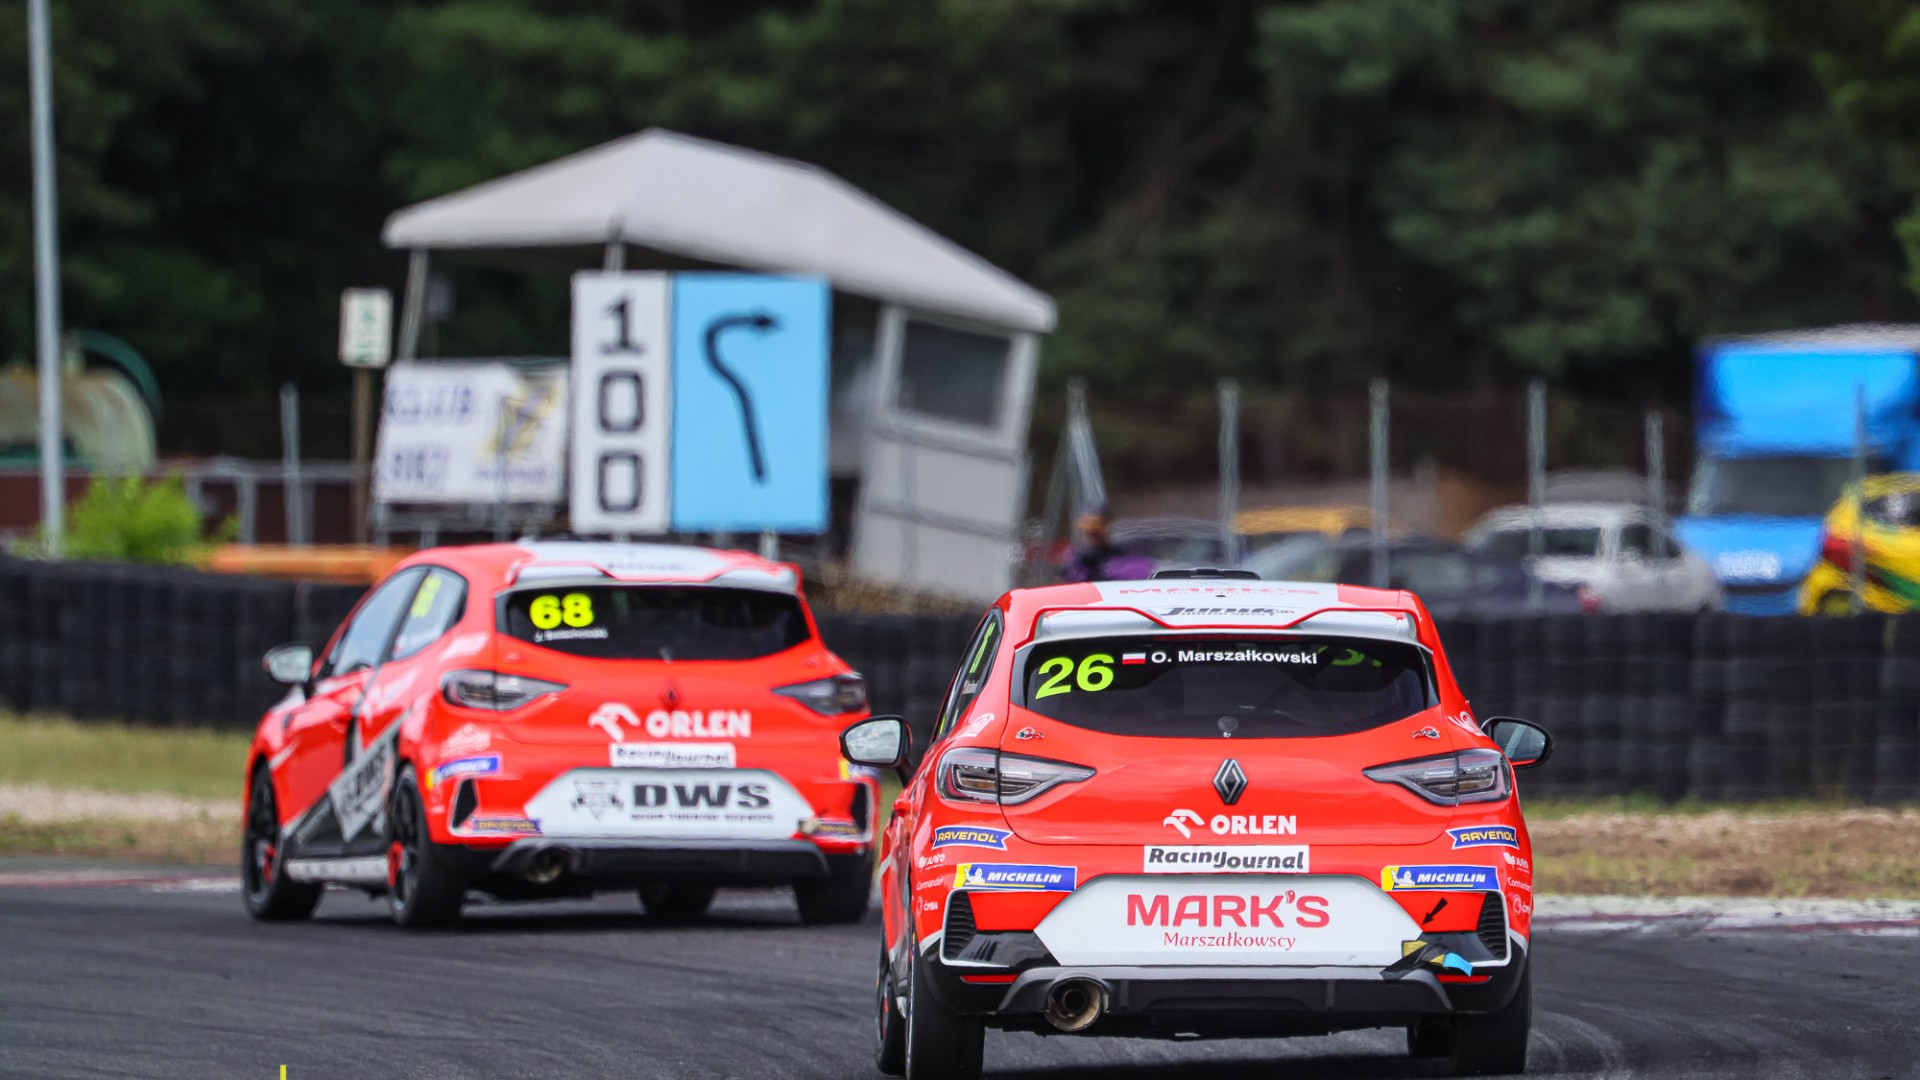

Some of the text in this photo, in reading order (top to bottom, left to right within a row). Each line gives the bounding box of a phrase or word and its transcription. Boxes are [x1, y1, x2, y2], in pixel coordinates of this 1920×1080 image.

[600, 295, 645, 513] 100
[529, 592, 595, 630] 68
[1035, 653, 1115, 700] 26
[1151, 651, 1172, 664] O.
[1178, 649, 1318, 665] Marszałkowski
[646, 710, 752, 738] ORLEN
[633, 783, 771, 810] DWS
[1210, 814, 1297, 836] ORLEN
[1459, 830, 1515, 843] RAVENOL
[937, 831, 998, 844] RAVENOL
[987, 872, 1063, 884] MICHELIN
[1416, 872, 1486, 883] MICHELIN
[1126, 889, 1330, 929] MARK'S
[1163, 931, 1297, 951] Marszałkowscy
